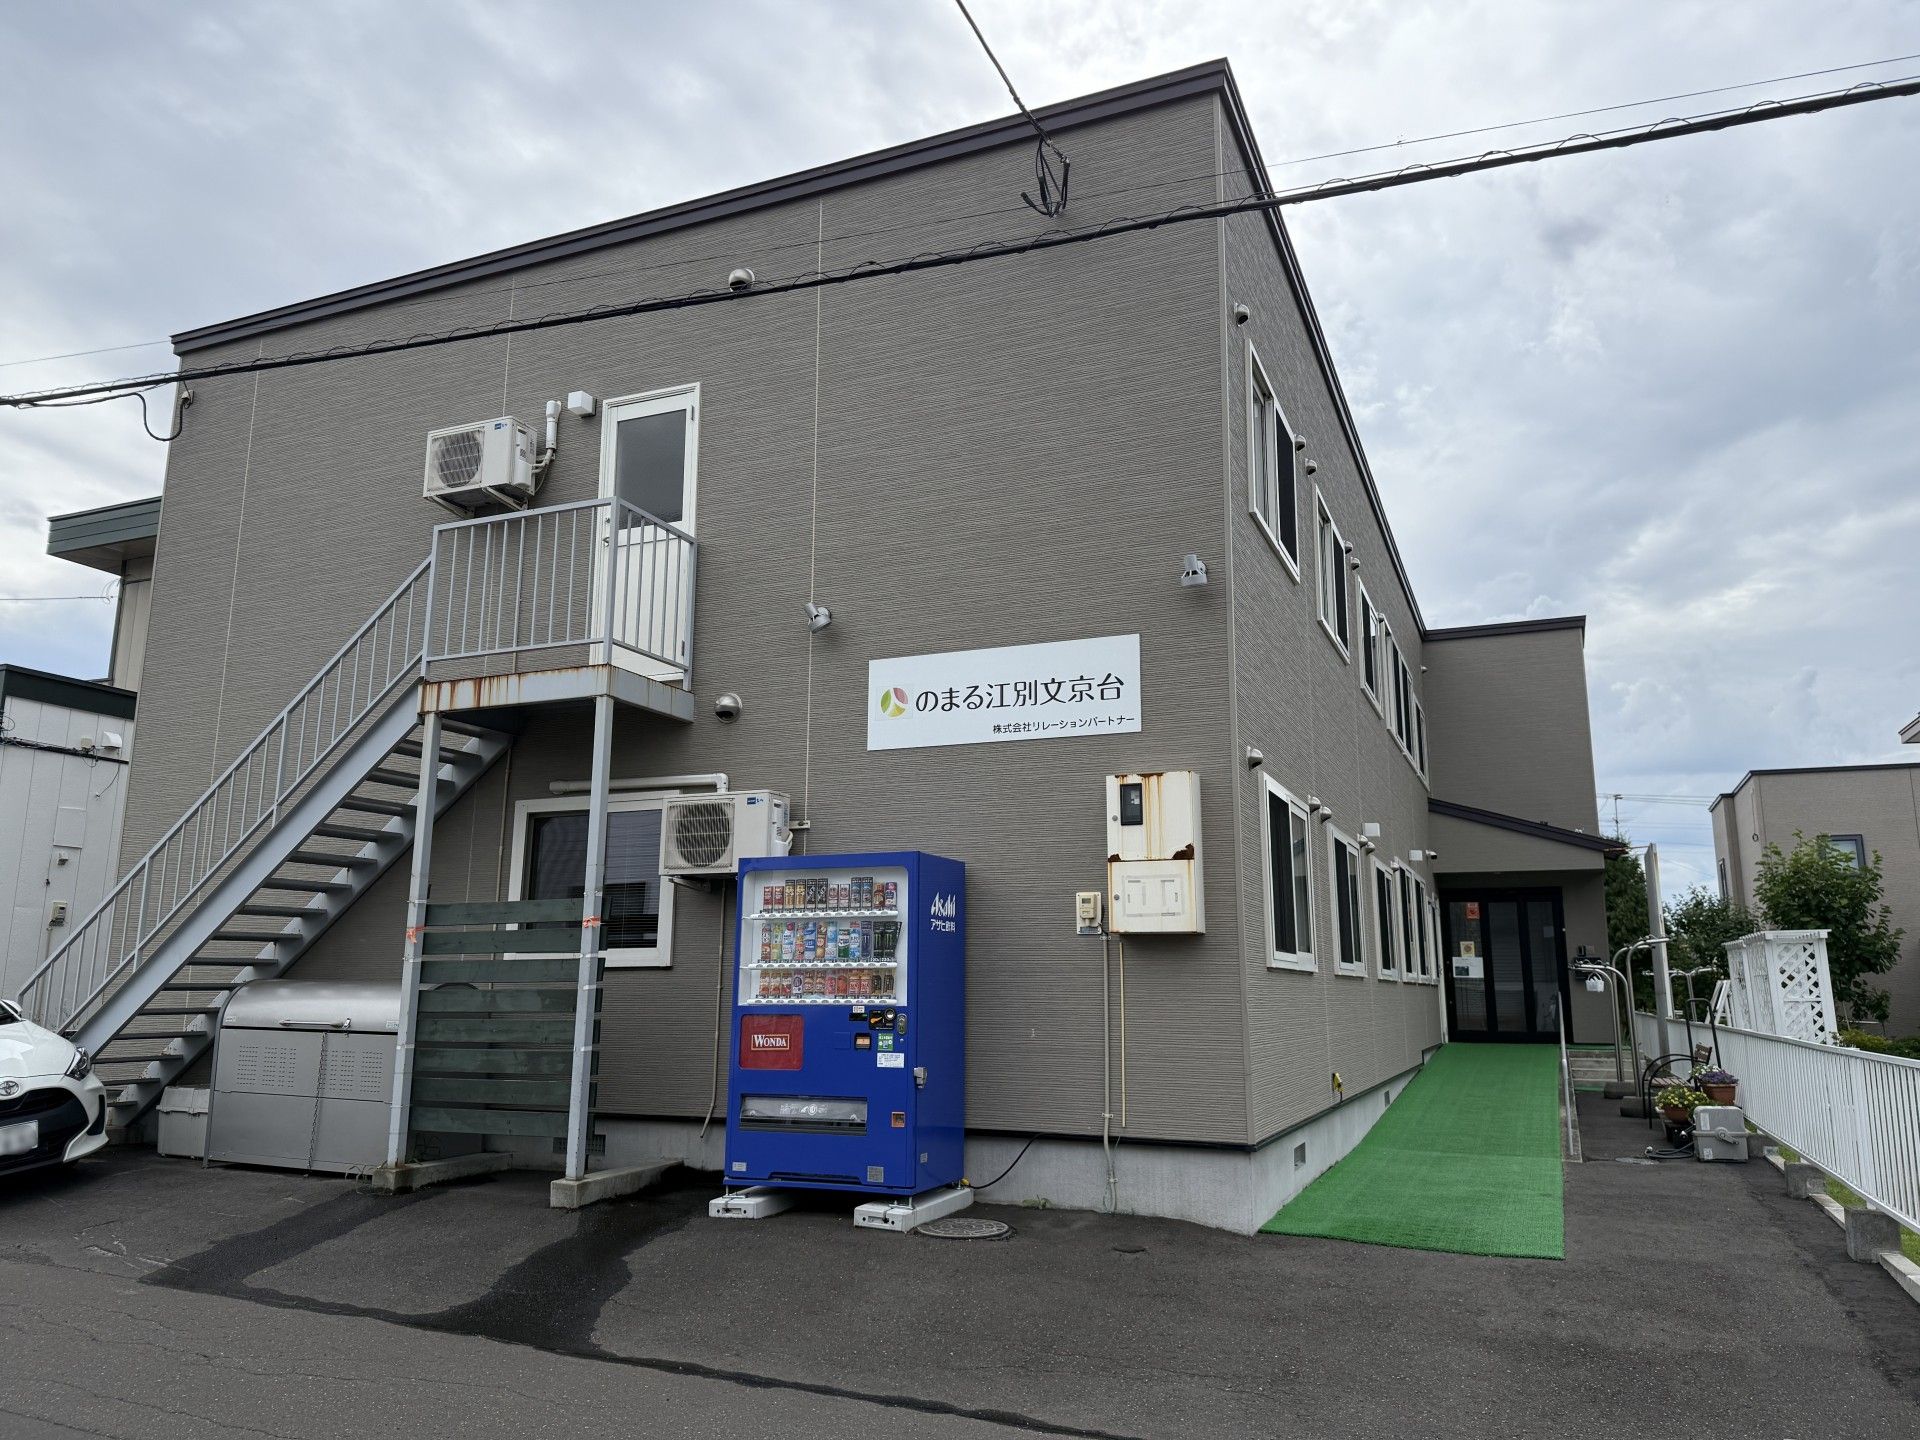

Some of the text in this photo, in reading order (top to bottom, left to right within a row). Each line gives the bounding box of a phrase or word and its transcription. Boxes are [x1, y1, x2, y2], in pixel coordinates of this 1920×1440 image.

[915, 672, 1125, 713] のまる江別文京台
[992, 715, 1135, 735] 株式会社リレーションパートナー
[930, 891, 956, 918] Asahi
[753, 1034, 787, 1048] WONDA
